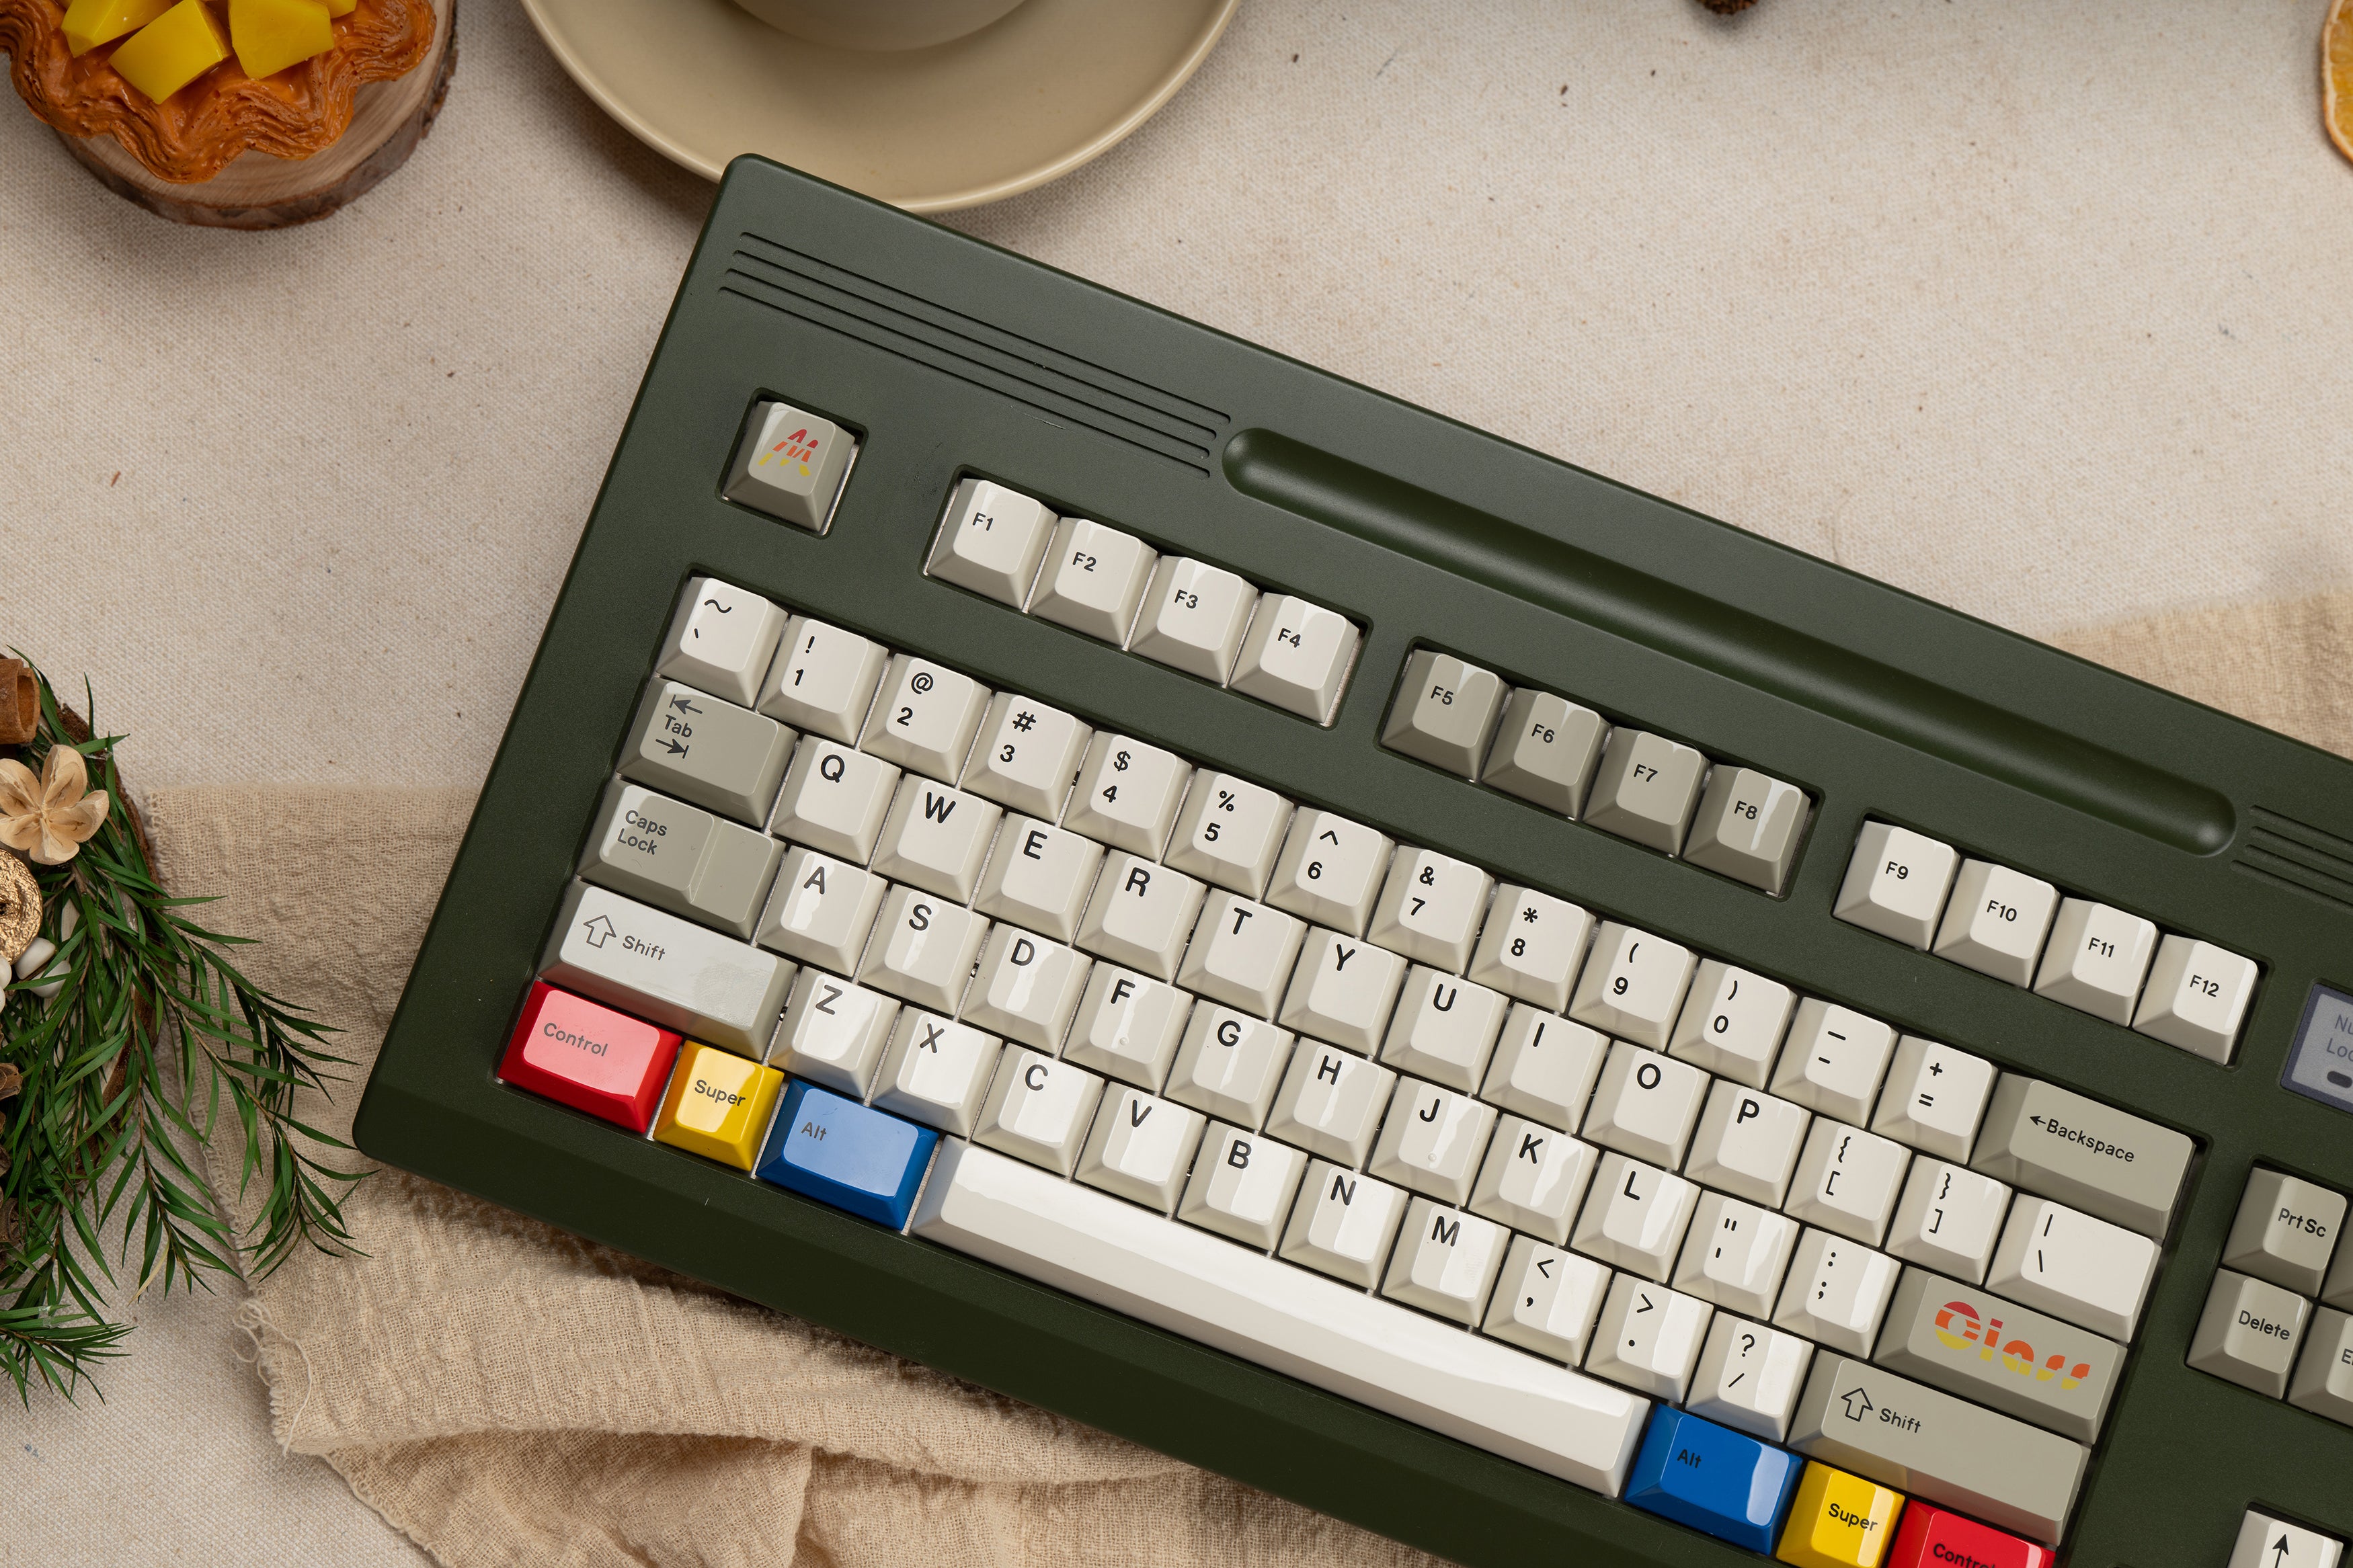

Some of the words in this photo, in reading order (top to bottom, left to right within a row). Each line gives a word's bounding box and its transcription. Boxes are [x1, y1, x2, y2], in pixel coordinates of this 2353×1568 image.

[972, 511, 994, 532] F1
[1072, 551, 1096, 573] F2
[704, 599, 732, 614] ~
[1174, 589, 1199, 610] F3
[805, 635, 815, 654] !
[1277, 627, 1301, 649] F4
[794, 669, 804, 686] 1
[910, 671, 934, 695] @
[1430, 685, 1454, 706] F5
[664, 714, 693, 739] Tab
[896, 706, 914, 727] 2
[1012, 710, 1037, 733] #
[1531, 723, 1555, 743] F6
[1000, 744, 1015, 763] 3
[1113, 750, 1131, 772] $
[820, 754, 845, 784] Q
[1633, 764, 1659, 783] F7
[1103, 785, 1117, 803] 4
[1218, 790, 1235, 812] %
[925, 791, 957, 825] W
[1734, 800, 1758, 820] F8
[625, 809, 667, 838] Caps
[1204, 822, 1221, 842] 5
[616, 827, 657, 856] Lock
[1023, 829, 1048, 860] E
[803, 866, 826, 895] A
[1125, 866, 1151, 897] R
[1307, 861, 1323, 880] 6
[1419, 866, 1435, 886] &
[1885, 860, 1909, 880] F9
[908, 903, 932, 932] S
[1410, 897, 1426, 916] 7
[1986, 899, 2018, 922] F10
[1232, 907, 1253, 936] T
[622, 935, 666, 961] Shift
[1010, 938, 1035, 966] D
[1336, 943, 1356, 972] Y
[1511, 938, 1526, 957] 8
[1628, 942, 1640, 964] (
[2087, 937, 2115, 958] F11
[1110, 979, 1136, 1005] F
[1433, 983, 1458, 1012] U
[1613, 977, 1629, 995] 9
[1727, 980, 1738, 1001] )
[2189, 974, 2219, 997] F12
[815, 984, 843, 1016] Z
[543, 1022, 608, 1057] Control
[919, 1023, 945, 1054] X
[1217, 1020, 1242, 1047] G
[1025, 1064, 1049, 1091] C
[1317, 1055, 1343, 1085] H
[1636, 1063, 1661, 1090] O
[1929, 1062, 1943, 1077] +
[694, 1079, 746, 1107] Super
[1918, 1093, 1934, 1107] =
[1131, 1099, 1152, 1128] V
[1419, 1098, 1441, 1122] J
[1737, 1098, 1760, 1124] P
[801, 1121, 827, 1141] Alt
[2045, 1118, 2135, 1163] Backspace
[1227, 1139, 1252, 1169] B
[1518, 1133, 1544, 1165] K
[1837, 1136, 1851, 1163] {
[1330, 1174, 1357, 1206] N
[1623, 1170, 1640, 1201] L
[1825, 1170, 1841, 1196] [
[1938, 1172, 1951, 1200] }
[1431, 1215, 1461, 1247] M
[1928, 1208, 1944, 1234] ]
[1536, 1258, 1554, 1279] <
[1636, 1293, 1654, 1313] >
[2238, 1309, 2290, 1340] Delete
[1741, 1333, 1755, 1358] ?
[1728, 1372, 1745, 1388] /
[1879, 1407, 1921, 1434] Shift
[1677, 1448, 1702, 1469] Alt
[1828, 1503, 1878, 1532] Super
